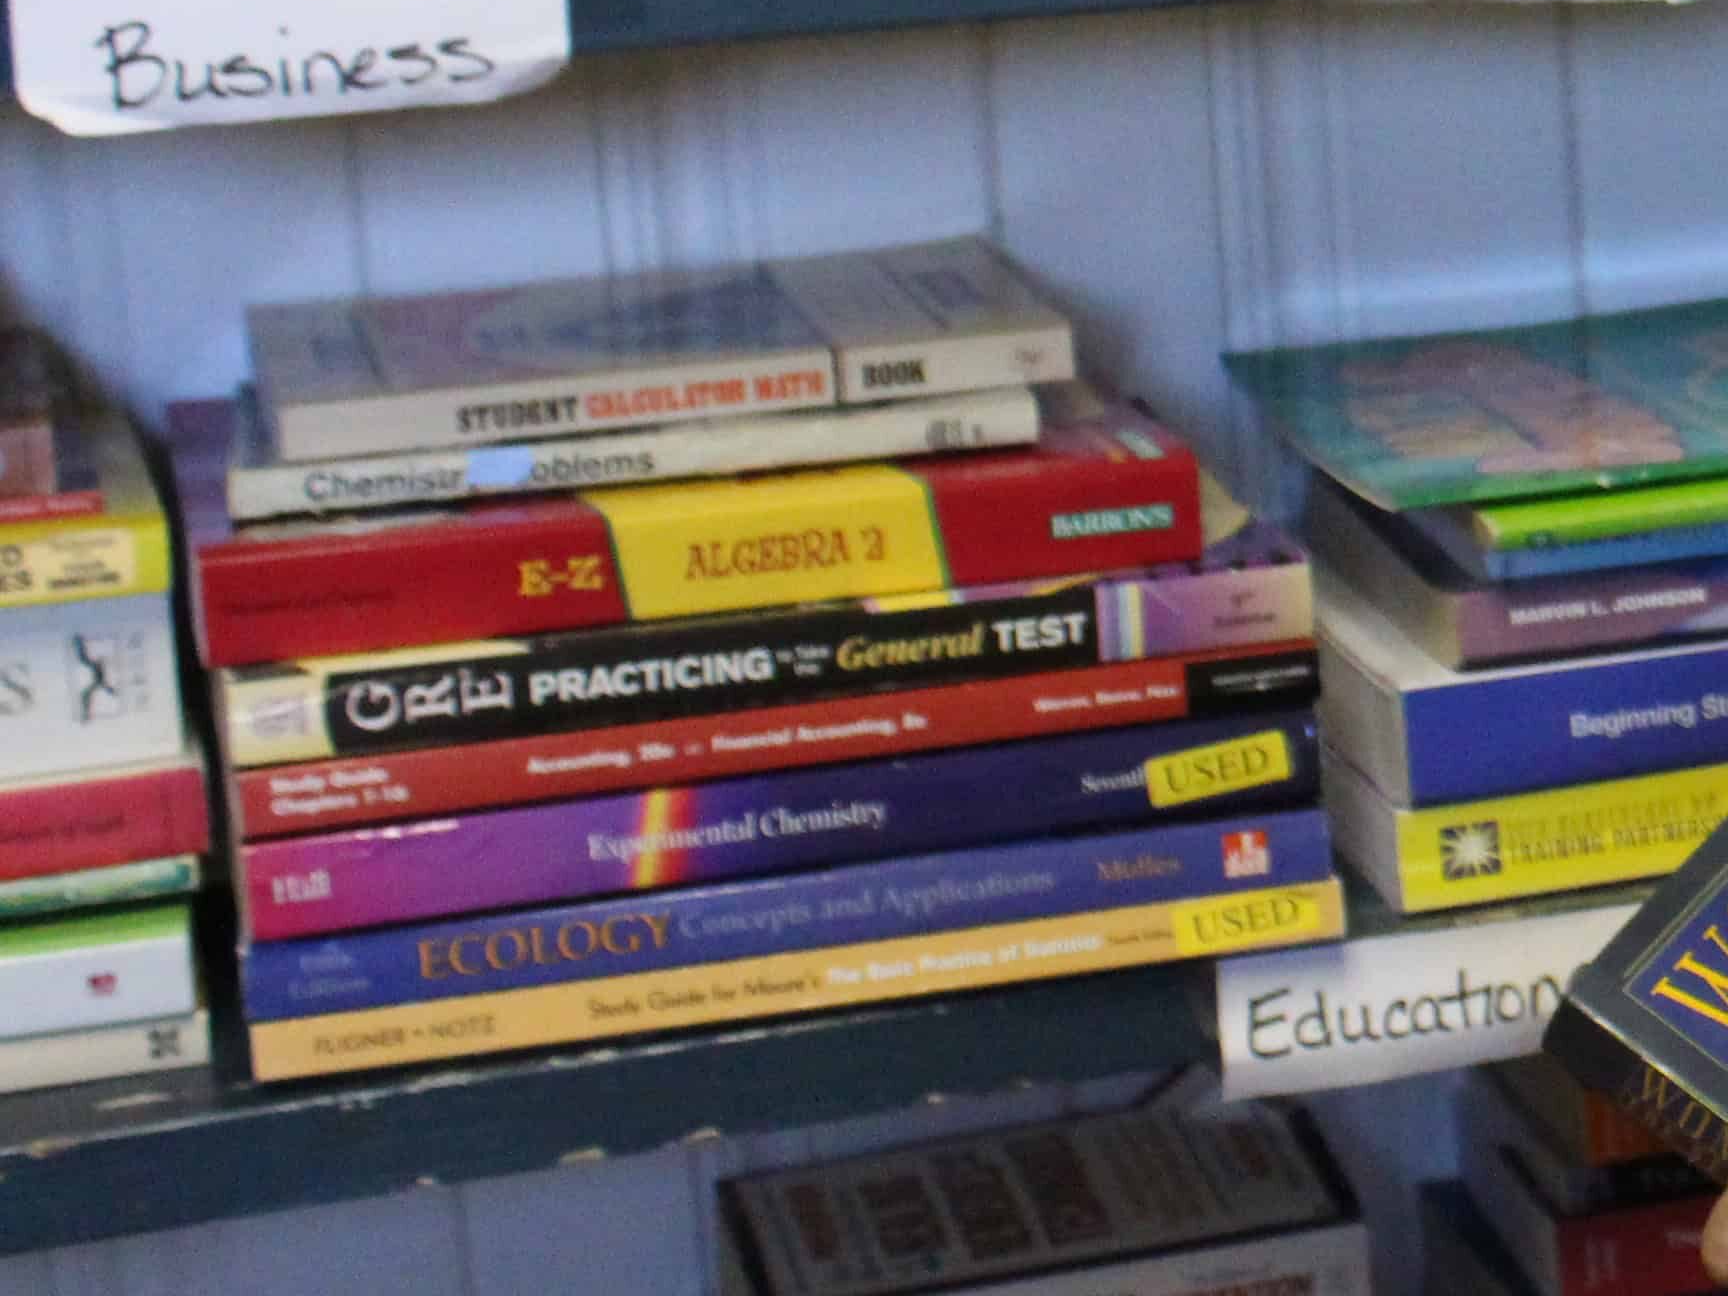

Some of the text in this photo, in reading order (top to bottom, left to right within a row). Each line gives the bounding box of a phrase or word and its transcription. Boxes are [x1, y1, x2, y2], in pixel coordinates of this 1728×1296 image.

[94, 19, 496, 108] Business
[456, 395, 578, 434] STUDENT
[583, 379, 747, 420] CALCULATOR
[862, 359, 925, 387] BOOK
[517, 556, 605, 596] E-Z
[685, 529, 850, 580] ALGEBRA
[860, 528, 886, 562] 2
[835, 612, 1089, 673] General TEST
[345, 646, 776, 730] GRE PRACTICING
[1568, 699, 1696, 740] Beginning
[1162, 745, 1272, 795] USED
[271, 800, 889, 905] Hall Experimental Chemistry
[415, 908, 672, 980] ECOLOGY
[677, 902, 810, 941] Concepts
[822, 892, 873, 923] and
[881, 868, 1058, 917] Applications
[1192, 892, 1301, 944] USED
[1248, 968, 1569, 1059] Education
